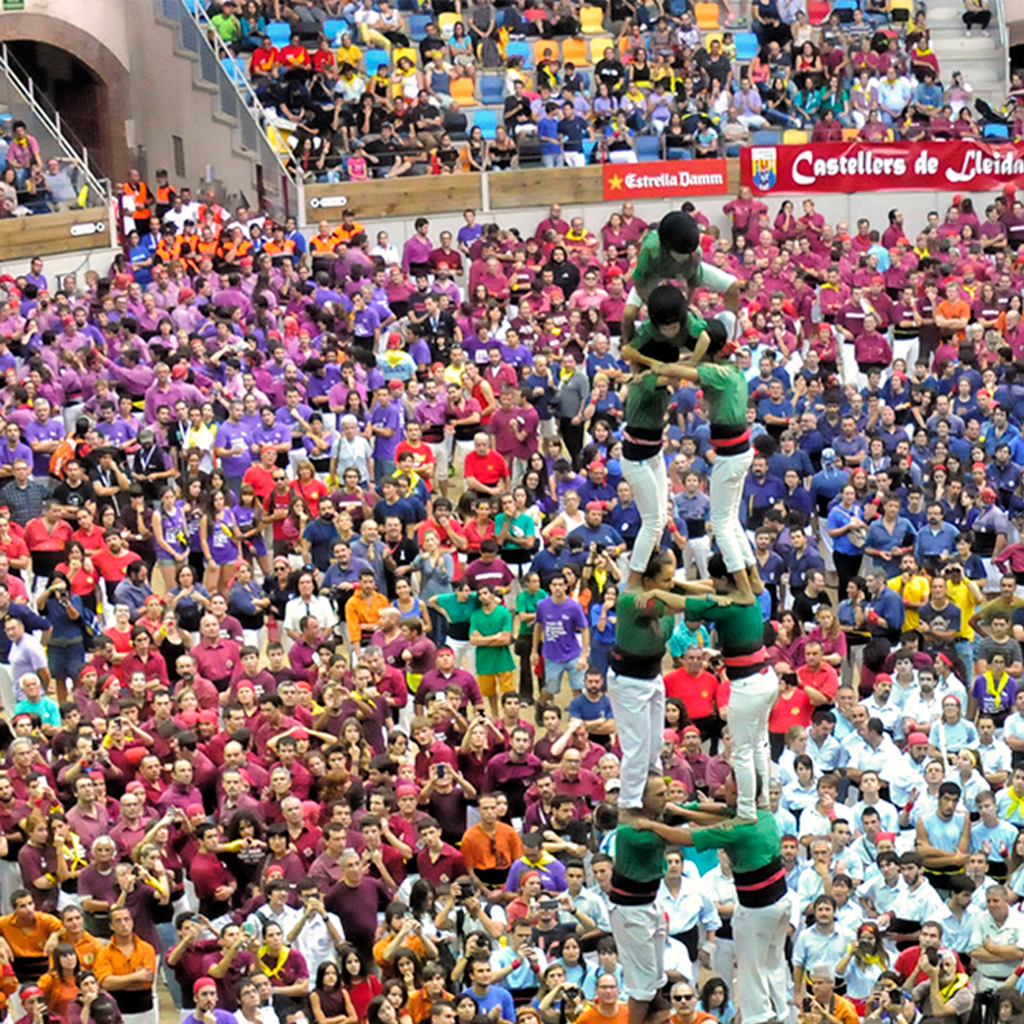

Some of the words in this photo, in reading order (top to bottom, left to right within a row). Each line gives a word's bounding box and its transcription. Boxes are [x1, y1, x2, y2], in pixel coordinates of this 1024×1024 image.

[625, 173, 678, 189] Estrella
[678, 171, 723, 187] Damm
[792, 150, 907, 185] Castellers
[915, 150, 939, 175] de
[945, 149, 1024, 183] Lleida
